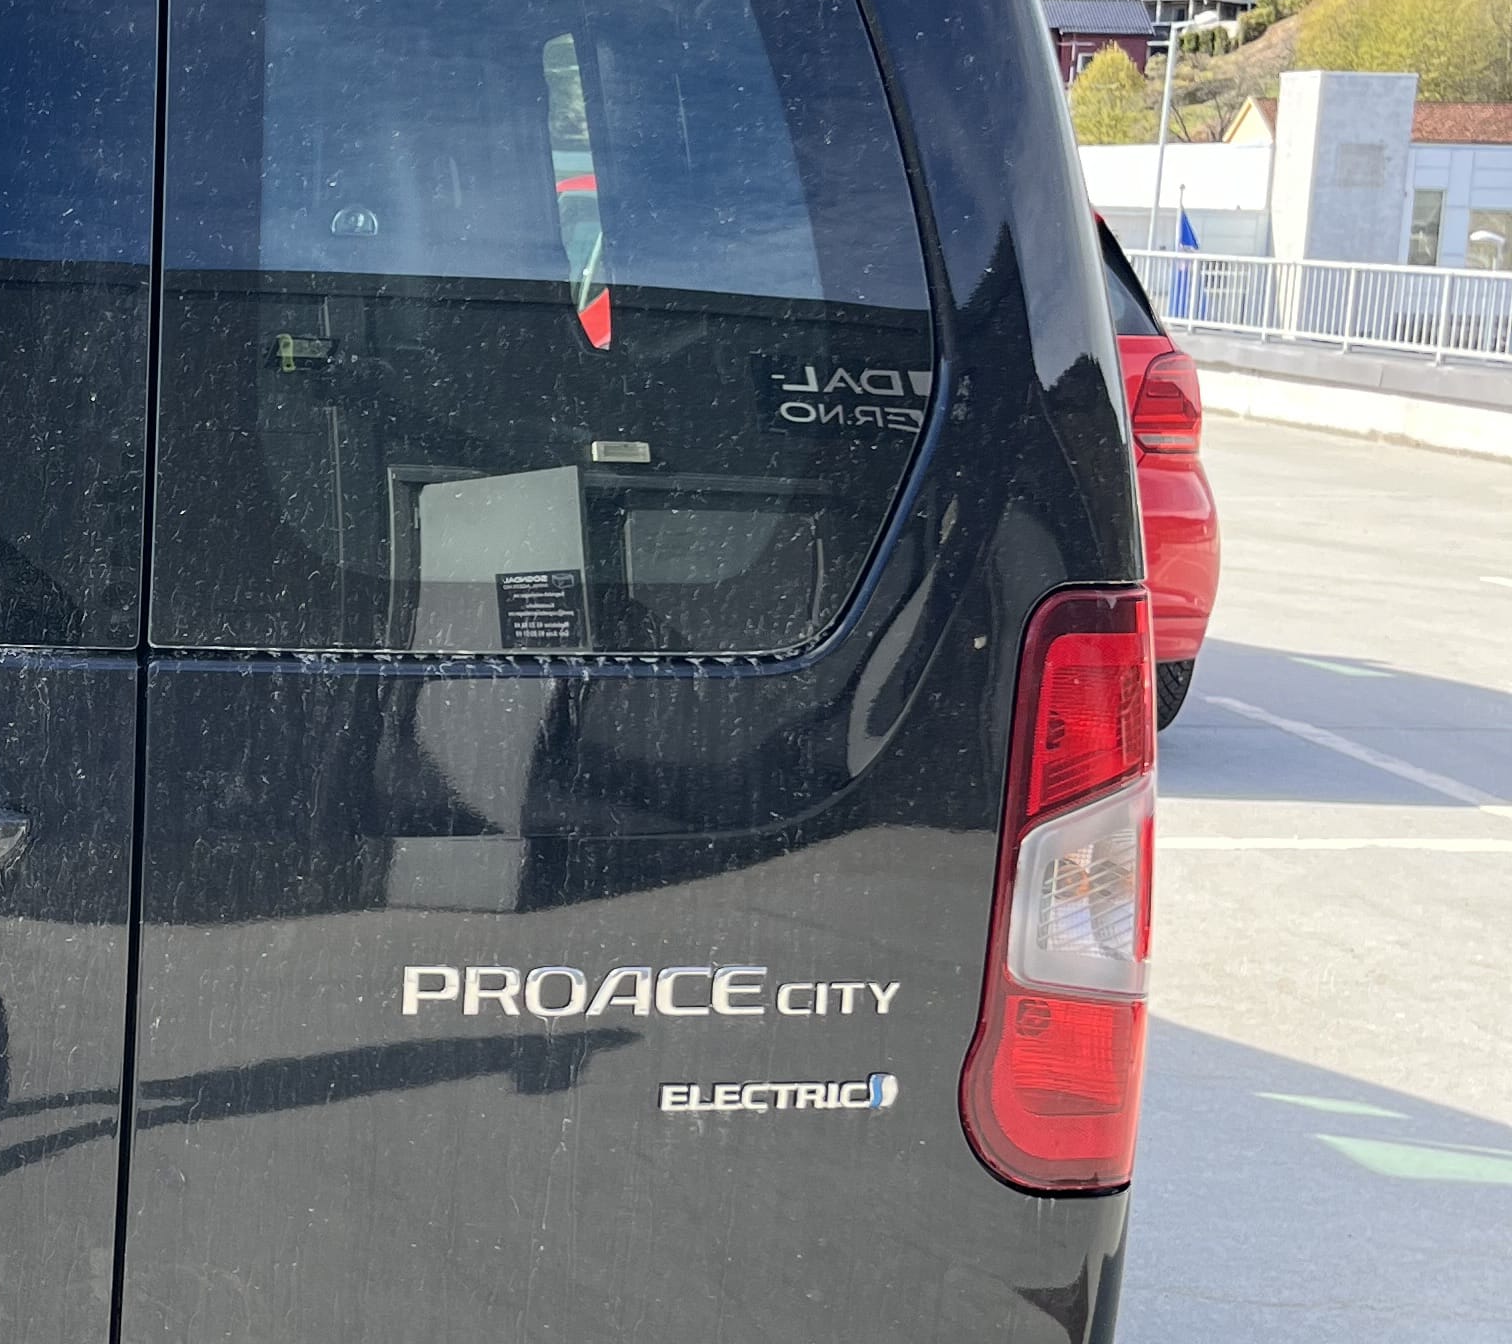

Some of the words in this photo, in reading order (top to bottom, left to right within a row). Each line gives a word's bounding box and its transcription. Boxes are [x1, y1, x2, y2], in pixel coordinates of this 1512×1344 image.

[401, 965, 768, 1017] PROACE
[776, 981, 901, 1016] CITY
[659, 1081, 871, 1112] ELECTRIC
